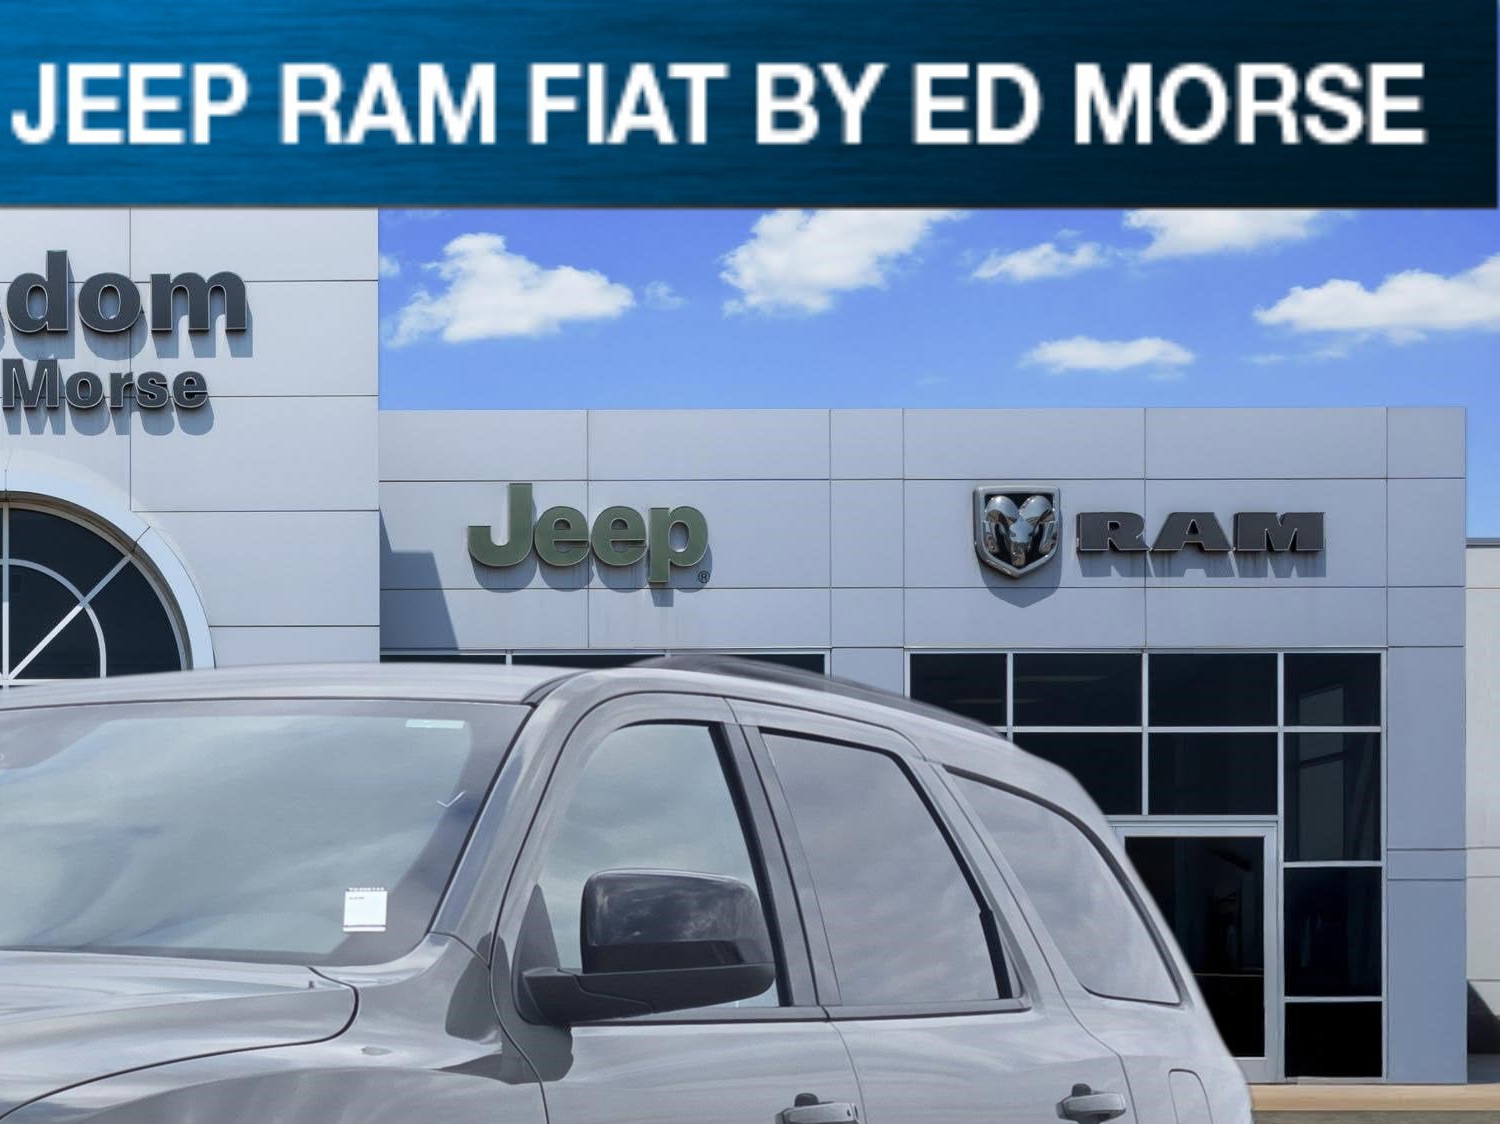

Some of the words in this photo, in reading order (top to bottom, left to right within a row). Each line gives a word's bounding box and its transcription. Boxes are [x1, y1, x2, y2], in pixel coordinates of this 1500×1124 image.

[2, 358, 208, 409] Morse
[467, 483, 709, 584] Jeep
[1075, 511, 1326, 552] RAM
